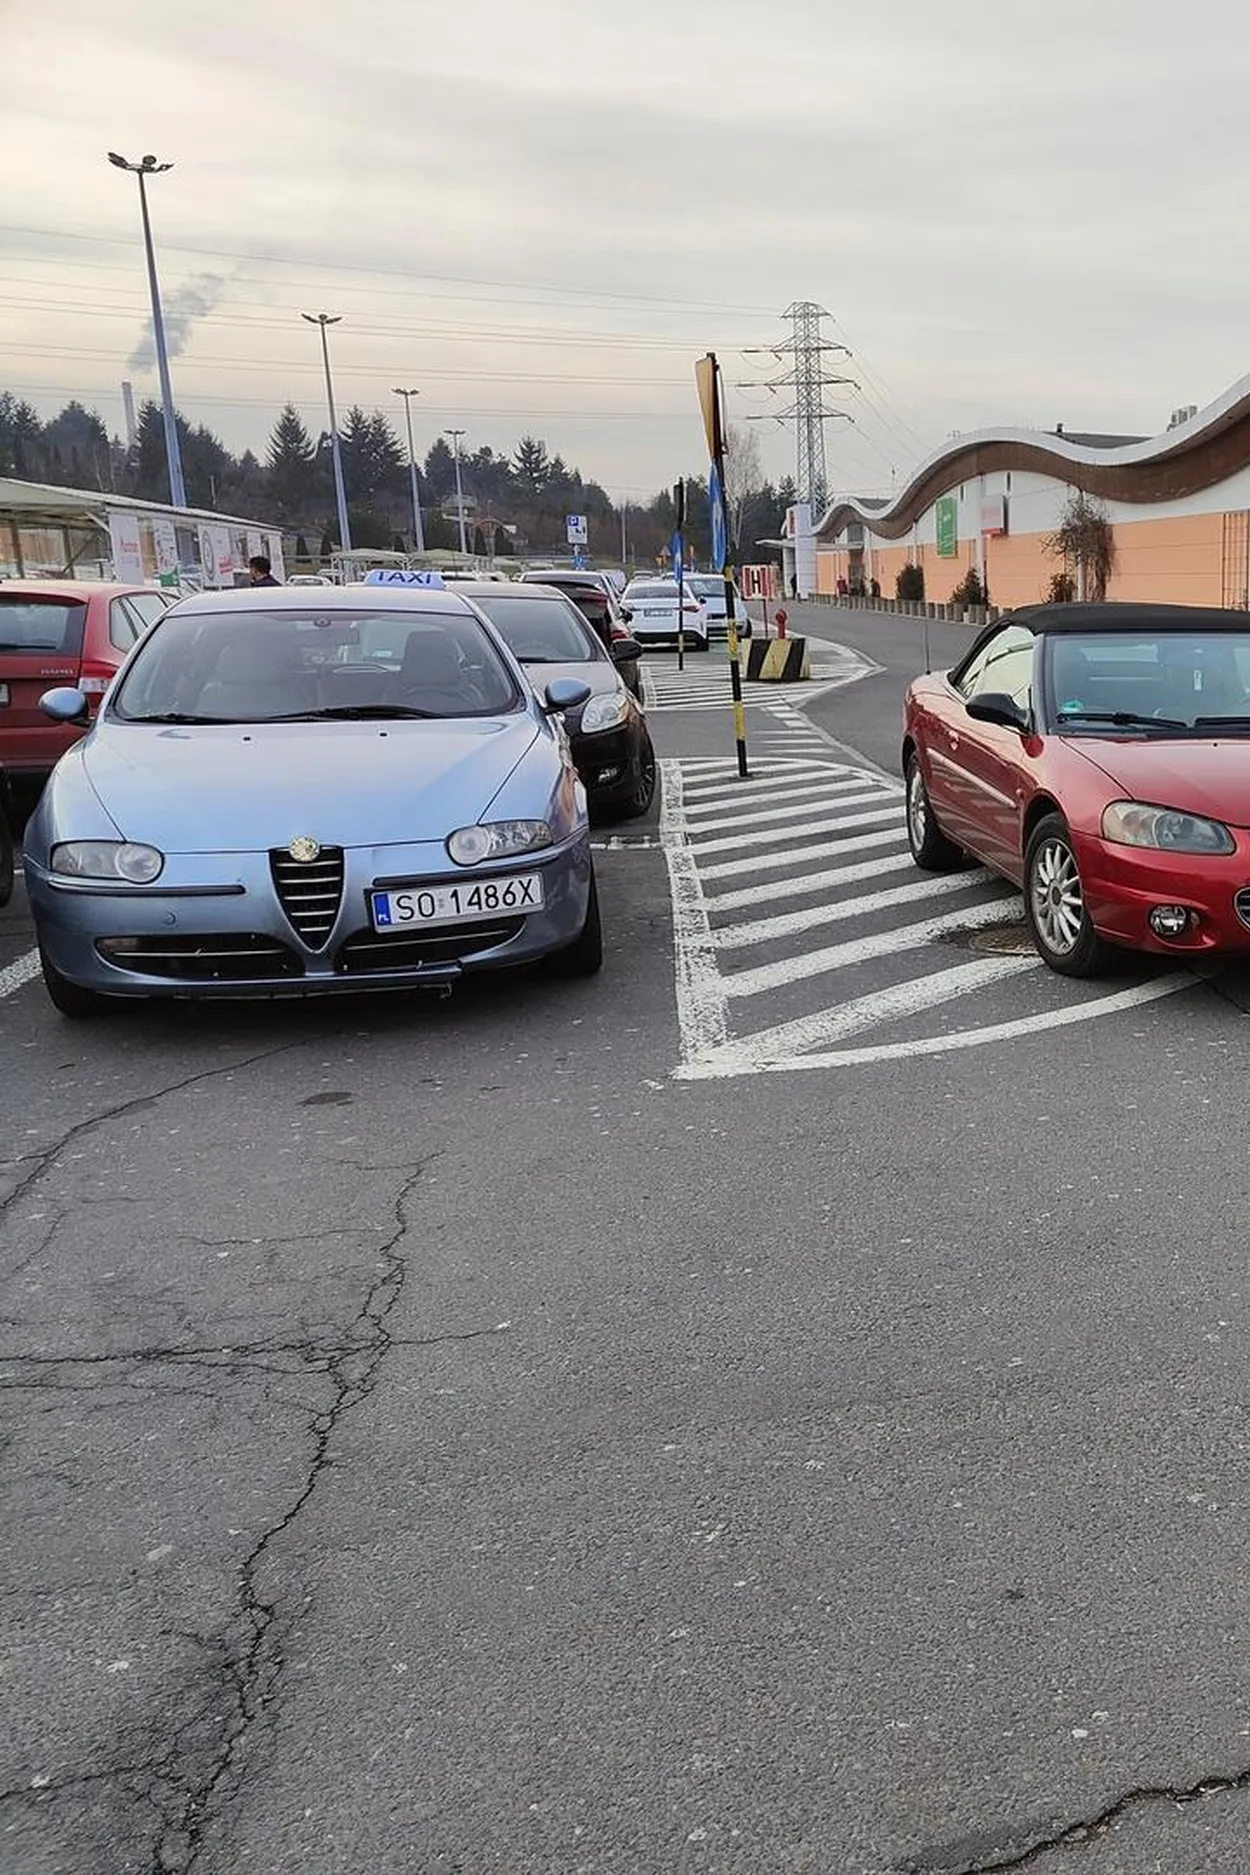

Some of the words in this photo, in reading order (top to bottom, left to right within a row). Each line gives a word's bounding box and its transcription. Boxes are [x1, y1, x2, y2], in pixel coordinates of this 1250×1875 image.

[376, 571, 431, 585] TAXI
[751, 570, 761, 594] H
[396, 892, 436, 921] SO
[449, 878, 535, 914] 1486X
